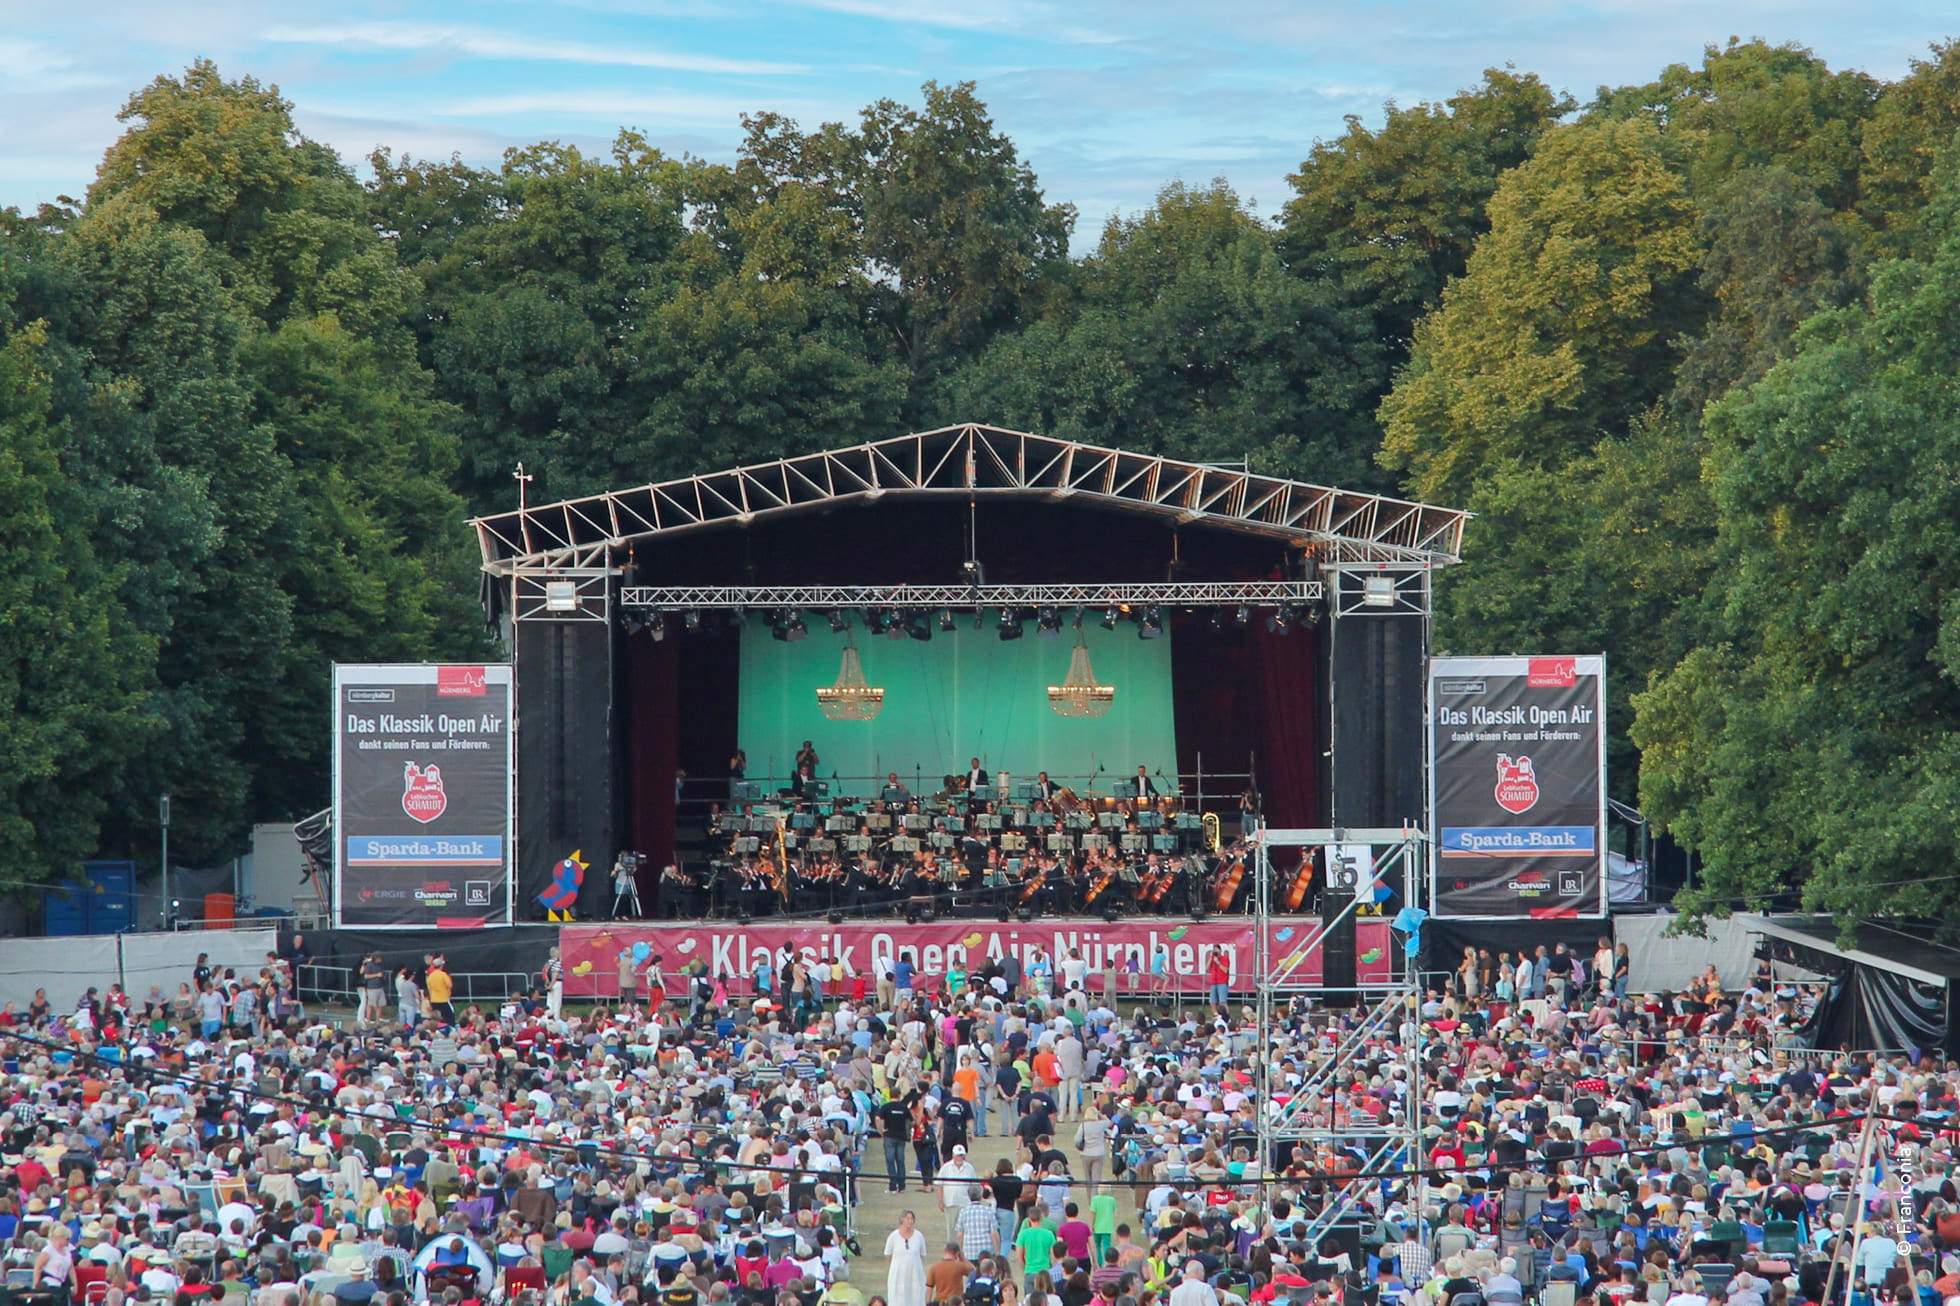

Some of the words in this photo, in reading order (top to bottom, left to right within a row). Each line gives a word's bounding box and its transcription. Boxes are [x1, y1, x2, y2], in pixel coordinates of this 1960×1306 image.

[1440, 707, 1468, 725] Das
[1472, 706, 1526, 725] Klassik
[1529, 705, 1567, 729] Open
[1571, 705, 1593, 724] Air
[347, 714, 376, 733] Das
[380, 714, 434, 733] Klassik
[438, 714, 475, 738] Open
[480, 714, 502, 733] Air
[1451, 731, 1473, 741] dankt
[1475, 731, 1501, 741] seinen
[1503, 730, 1522, 741] Fans
[1524, 730, 1538, 740] und
[1540, 729, 1581, 740] Förderern:
[359, 739, 382, 750] dankt
[383, 739, 409, 750] seinen
[411, 739, 429, 750] Fans
[431, 739, 447, 749] und
[449, 738, 491, 750] Förderern:
[1500, 791, 1535, 801] SCHMIDT
[407, 800, 442, 810] SCHMIDT
[1460, 831, 1577, 850] Sparda-Bank
[367, 841, 484, 858] Sparda-Bank
